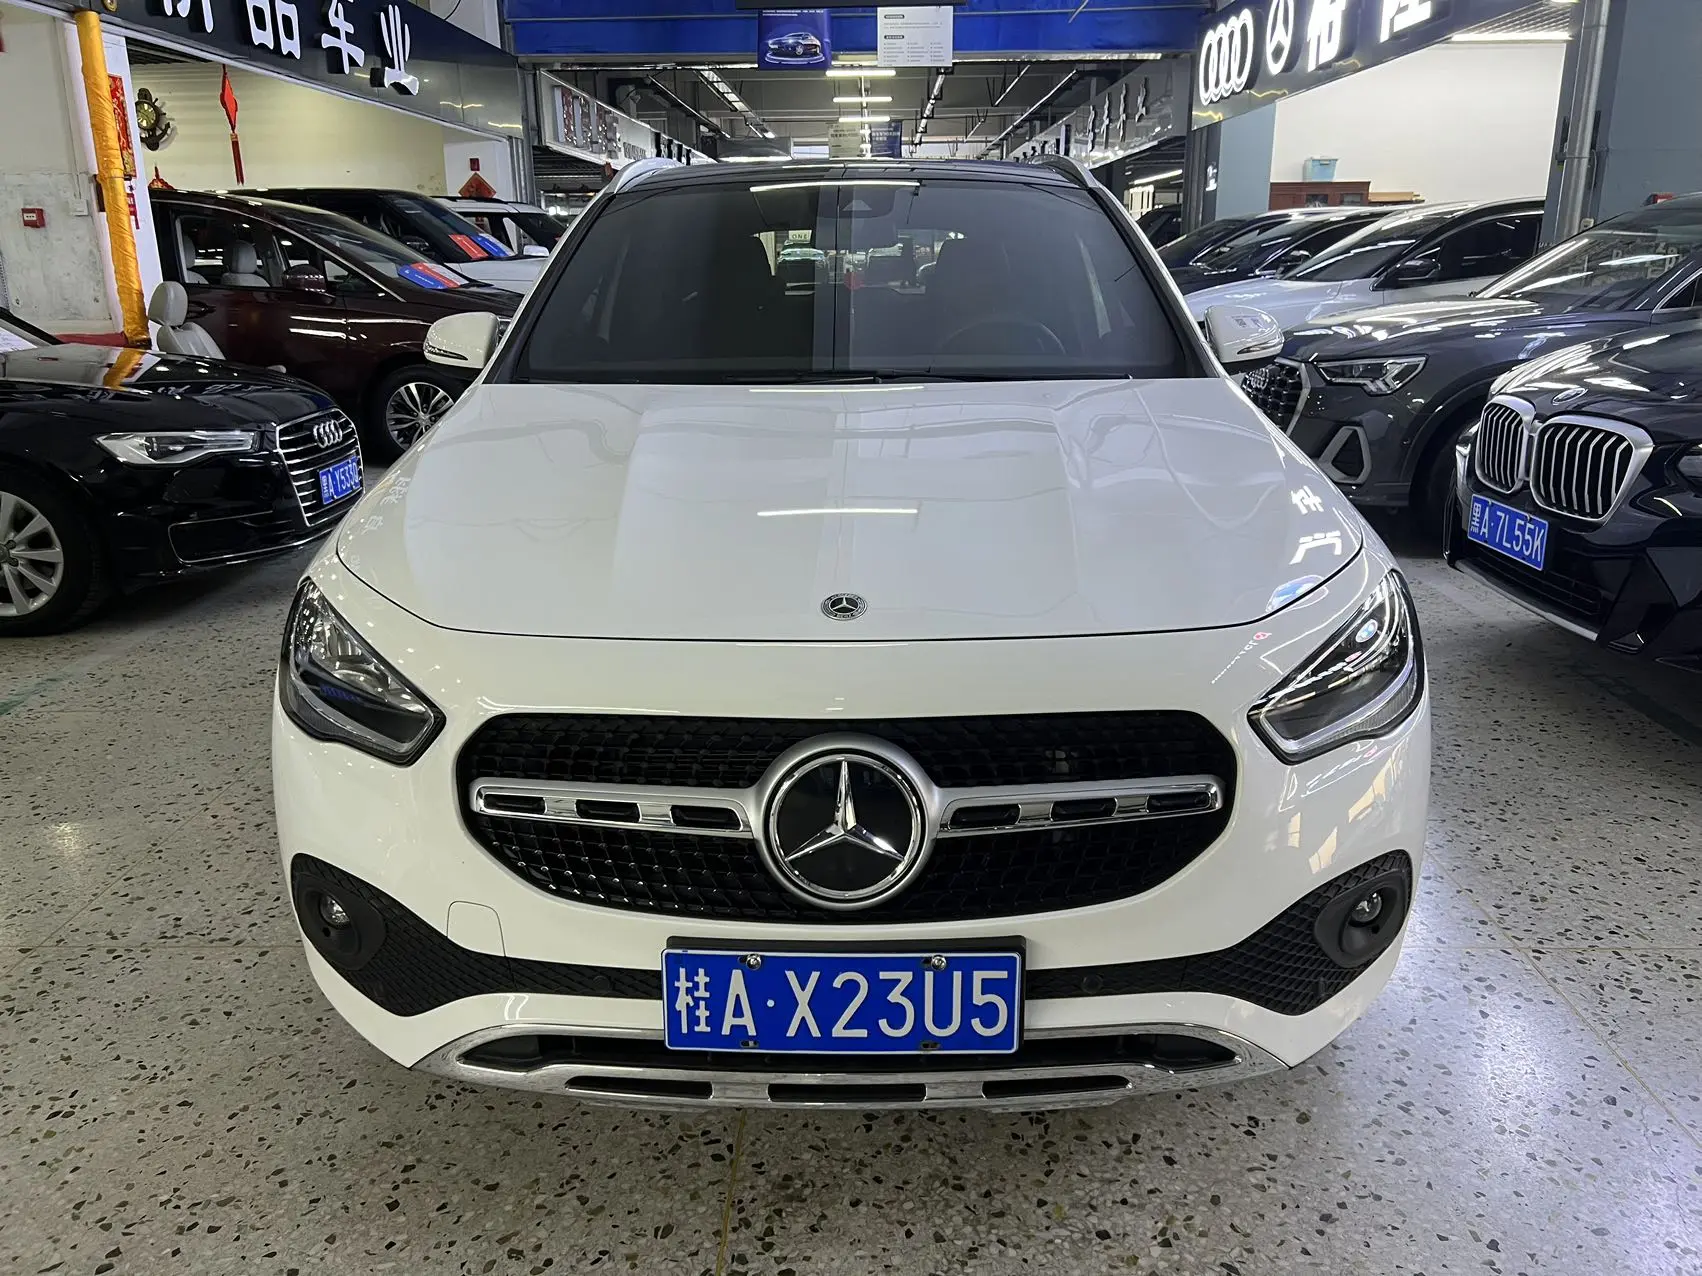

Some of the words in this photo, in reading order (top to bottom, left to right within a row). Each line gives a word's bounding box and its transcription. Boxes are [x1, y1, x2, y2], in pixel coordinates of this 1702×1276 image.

[163, 0, 419, 96] 品车业
[1470, 502, 1544, 562] 黑A·7L55K
[674, 967, 1008, 1038] 桂A·X23U5
